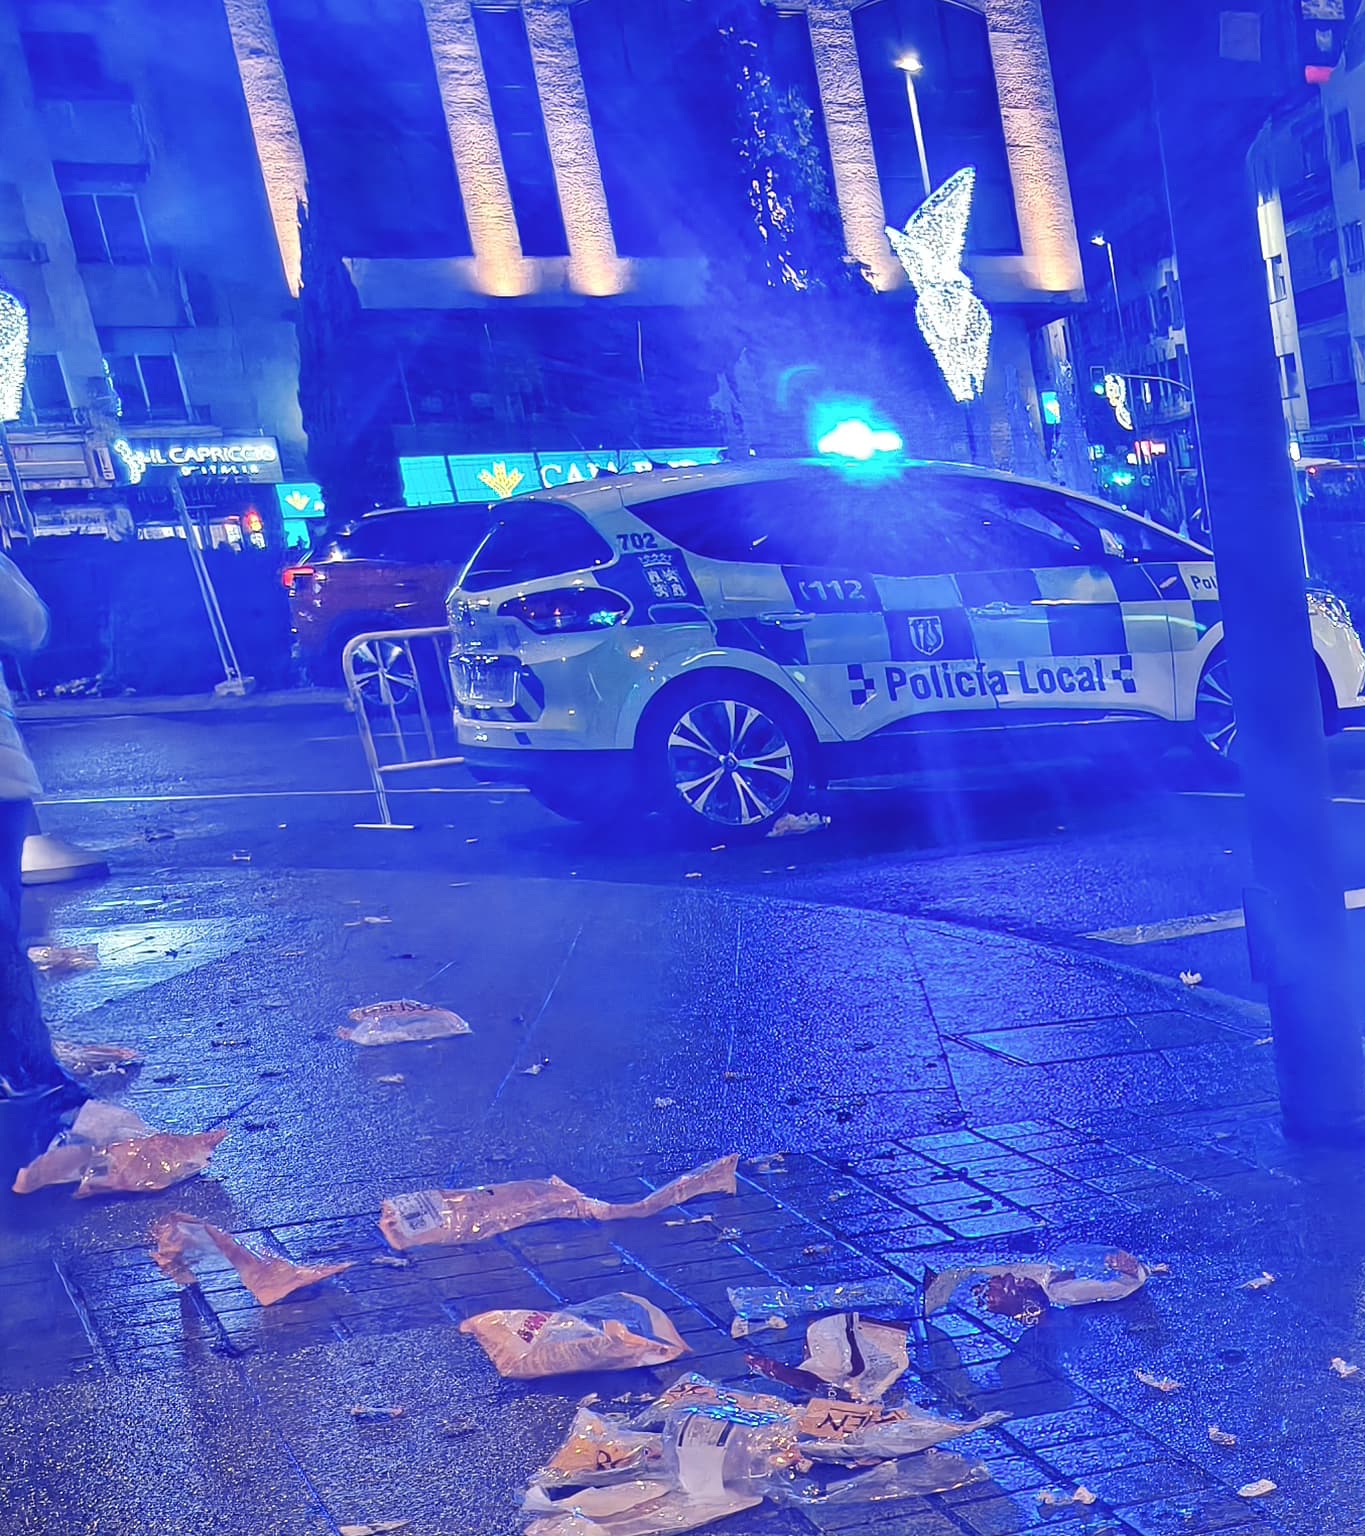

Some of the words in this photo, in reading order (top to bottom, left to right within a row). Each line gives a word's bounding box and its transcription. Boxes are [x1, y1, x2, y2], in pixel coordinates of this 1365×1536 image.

[168, 446, 277, 464] CAPRICCIO
[616, 533, 659, 551] 702
[1017, 658, 1106, 695] Local
